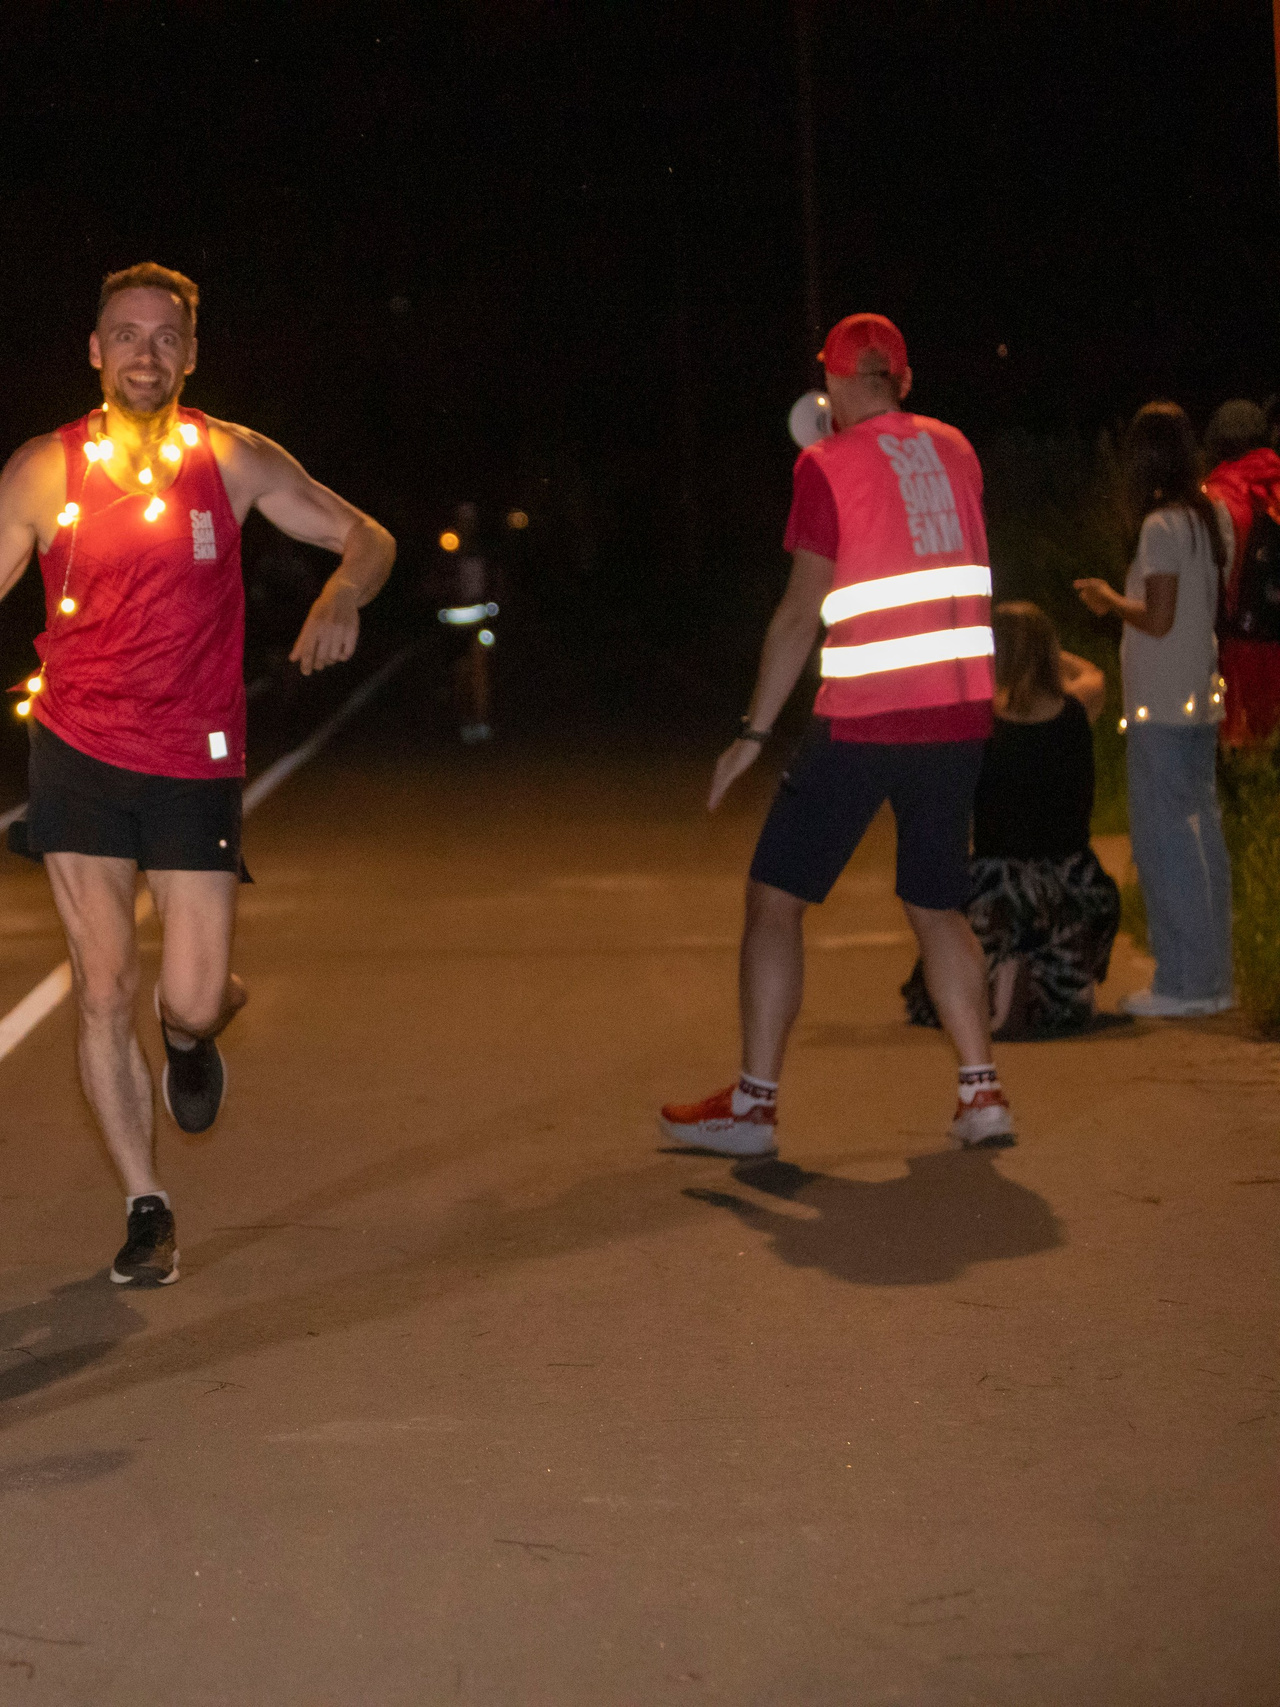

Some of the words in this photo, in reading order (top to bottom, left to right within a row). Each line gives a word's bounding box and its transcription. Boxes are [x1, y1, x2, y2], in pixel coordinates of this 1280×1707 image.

[878, 431, 944, 475] Sat
[898, 469, 955, 515] 9AM
[190, 509, 213, 528] Sat
[908, 509, 963, 556] 5KM
